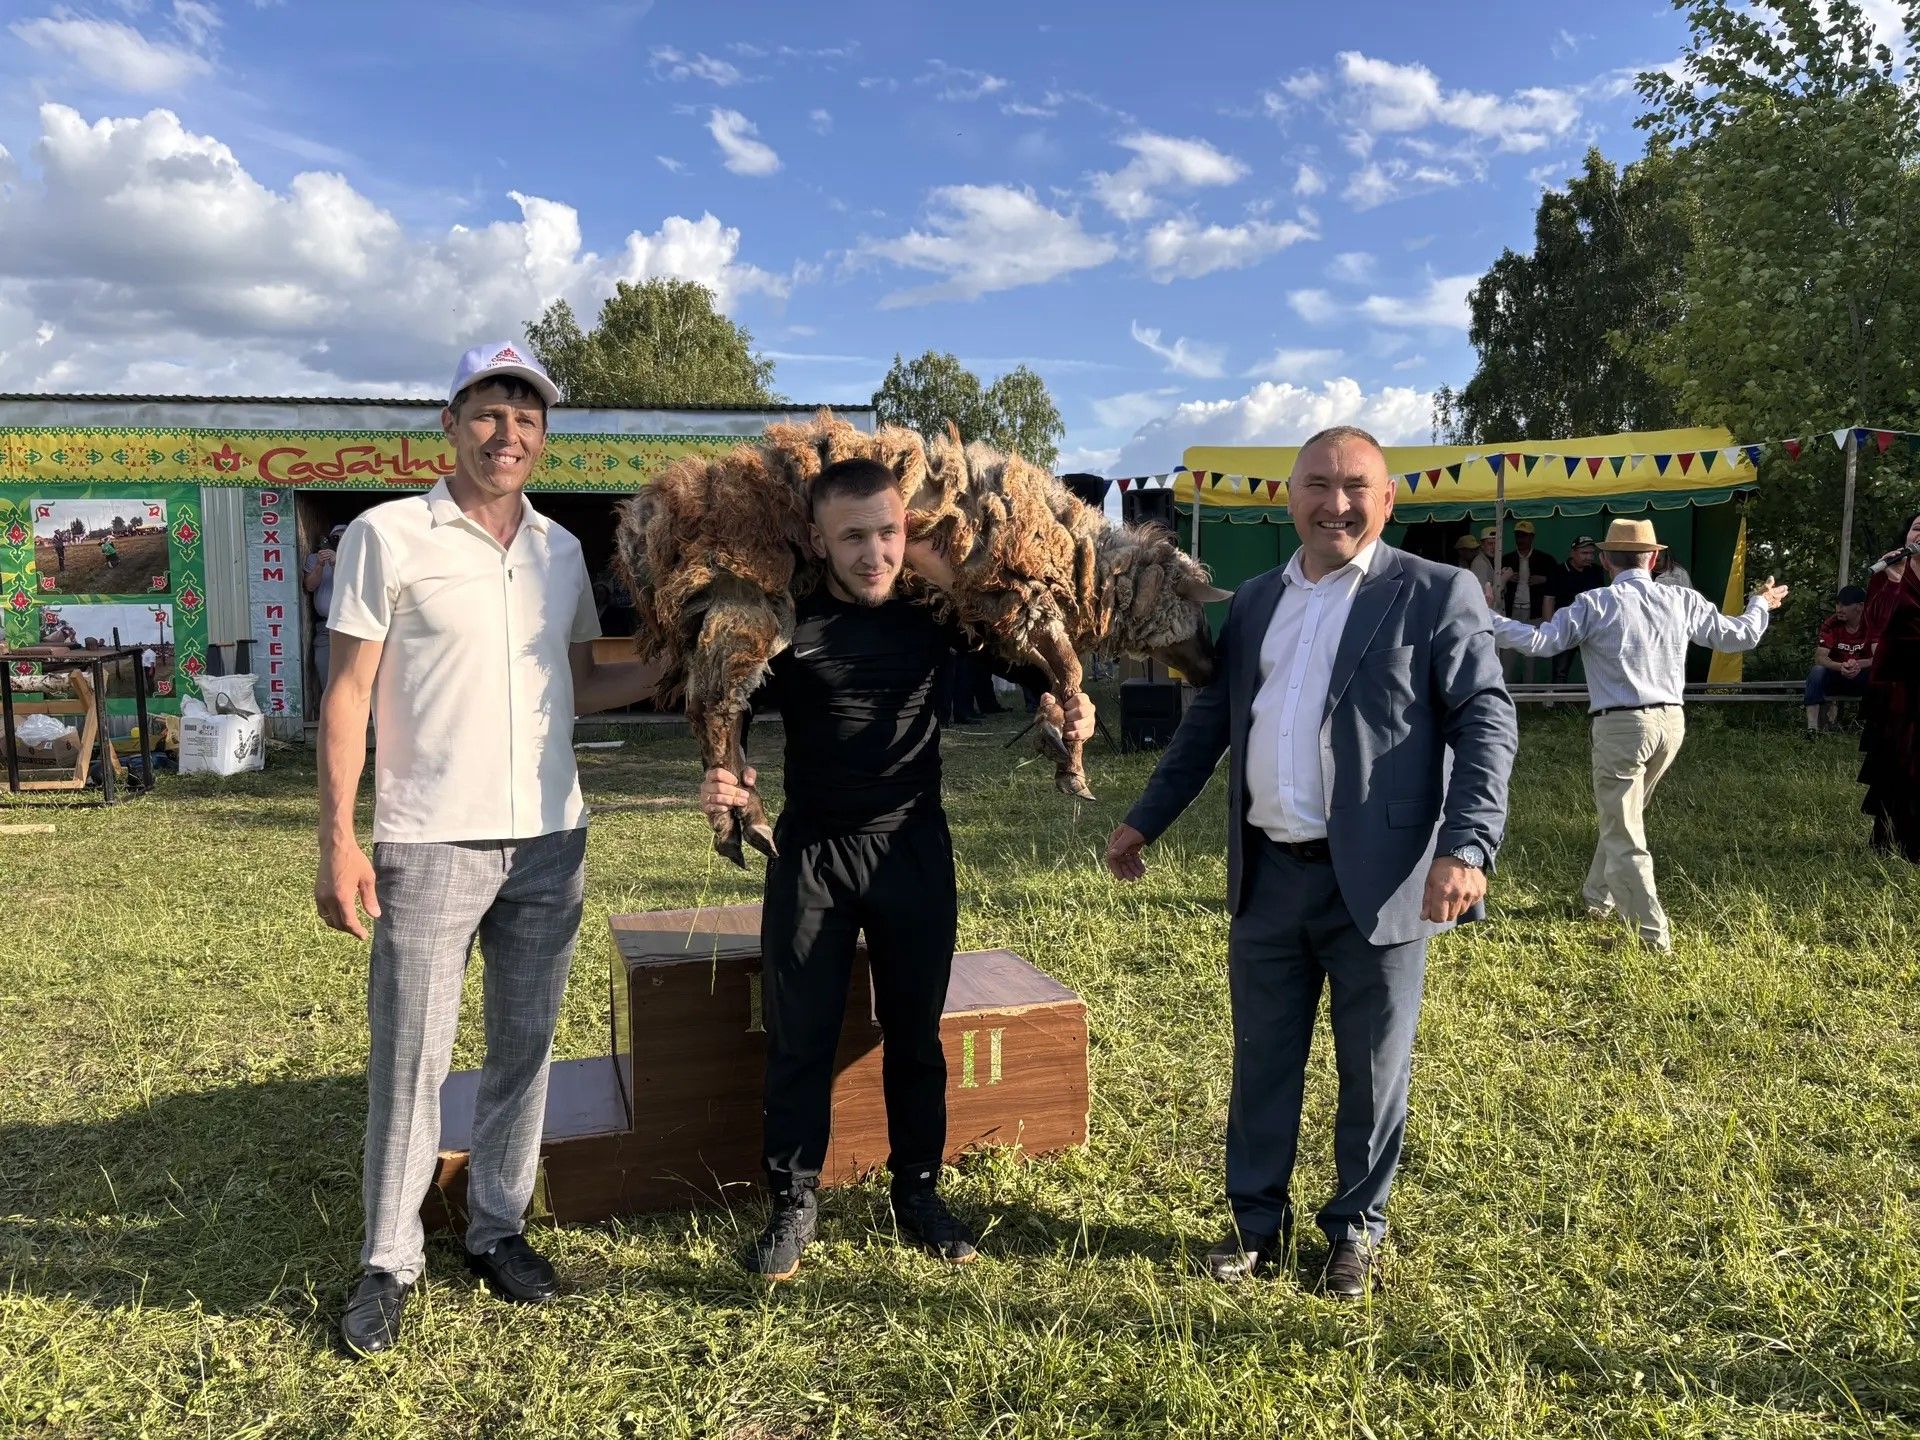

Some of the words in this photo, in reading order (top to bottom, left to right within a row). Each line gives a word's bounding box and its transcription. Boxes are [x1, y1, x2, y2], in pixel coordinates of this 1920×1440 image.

[260, 492, 284, 582] РӘХИМ
[265, 604, 285, 713] ИТЕГЕЗ
[958, 1027, 1007, 1089] II
